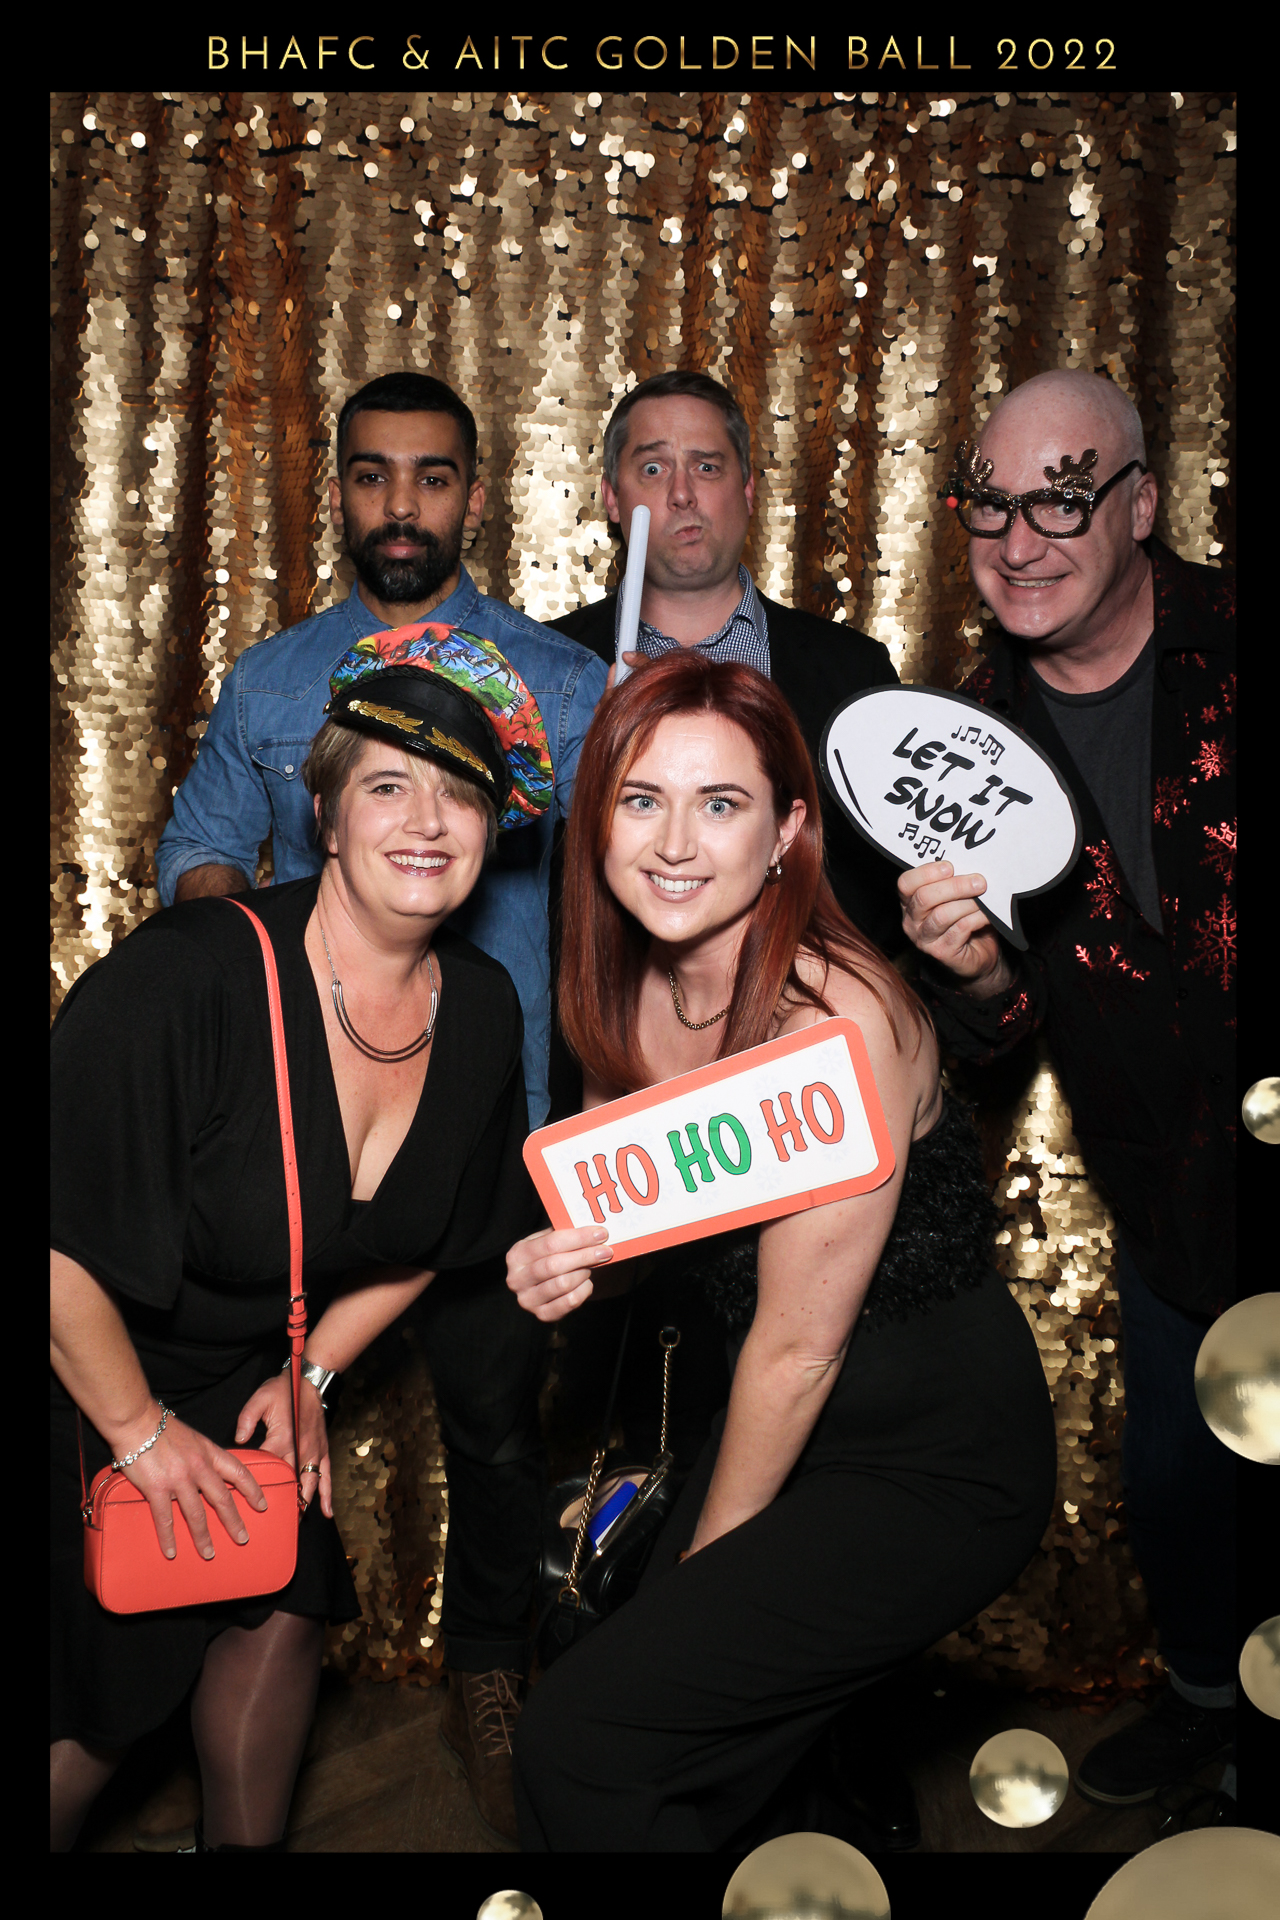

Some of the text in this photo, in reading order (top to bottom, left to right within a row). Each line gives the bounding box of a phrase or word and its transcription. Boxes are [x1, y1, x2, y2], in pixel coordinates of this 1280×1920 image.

[884, 776, 996, 851] SNOW
[892, 727, 1034, 817] LET IT
[574, 1081, 845, 1223] HO HO HO
